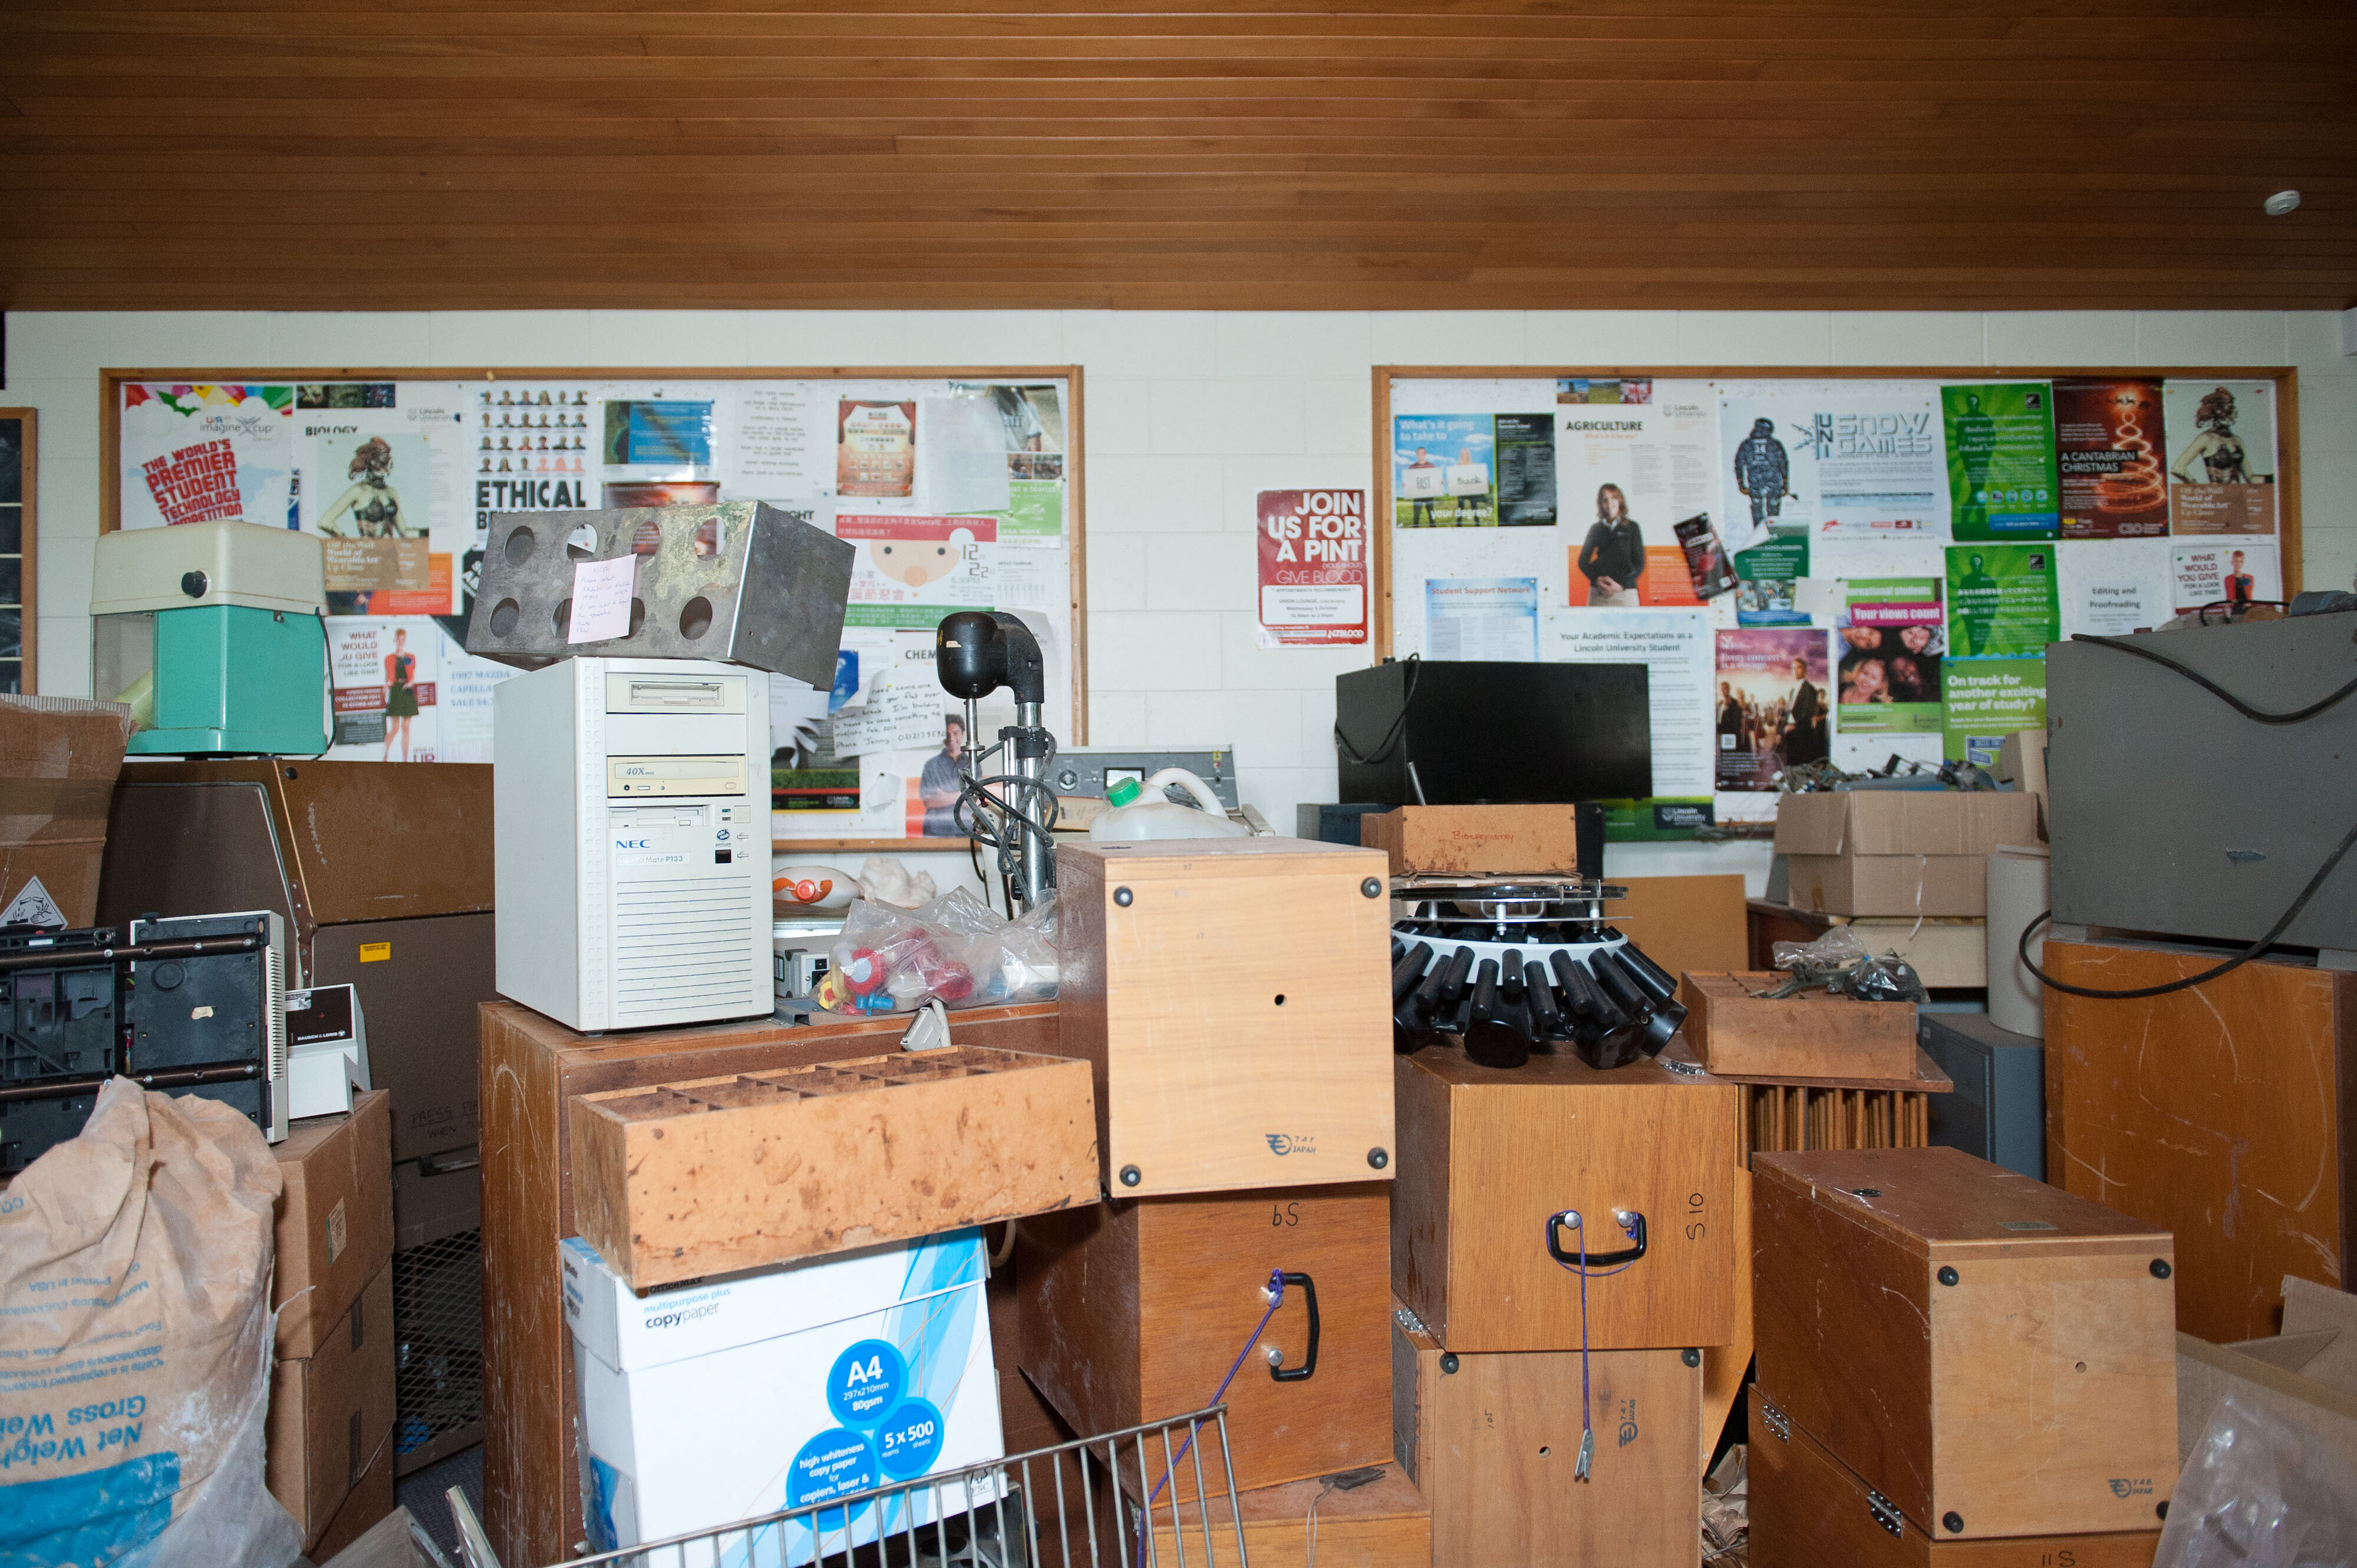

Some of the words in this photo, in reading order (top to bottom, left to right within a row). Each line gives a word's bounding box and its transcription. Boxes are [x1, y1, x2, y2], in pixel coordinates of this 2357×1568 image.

[199, 423, 241, 434] imagine
[252, 424, 272, 434] cup
[1400, 420, 1436, 430] What's
[1448, 420, 1474, 431] going
[1565, 421, 1643, 431] AGRICULTURE
[1837, 412, 1930, 435] SNOW
[305, 425, 358, 436] BIOLOGY
[1400, 431, 1412, 441] to
[1413, 431, 1434, 440] take
[1436, 431, 1447, 440] to
[141, 455, 167, 474] THE
[171, 438, 232, 461] WORLD'S
[2061, 452, 2070, 461] A
[2071, 451, 2135, 461] CANTABRIAN
[145, 451, 237, 492] PREMIER
[2061, 462, 2119, 472] CHRISTMAS
[153, 470, 237, 509] STUDENT
[476, 480, 586, 507] ETHICAL
[161, 489, 240, 521] TECHNOLOGY
[1294, 492, 1361, 516] JOIN
[1430, 509, 1453, 520] your
[1454, 507, 1494, 519] degree?
[1267, 516, 1302, 539] US
[1308, 516, 1362, 539] FOR
[1275, 539, 1298, 562] A
[1304, 539, 1362, 562] PINT
[2184, 563, 2218, 572] WOULD
[1275, 570, 1309, 583] GIVE
[1313, 569, 1363, 583] BLOOD
[2177, 574, 2197, 582] YOU
[2198, 572, 2220, 580] GIVE
[1431, 586, 1462, 595] Student
[1465, 586, 1495, 595] Support
[2092, 586, 2119, 595] Editing
[2089, 600, 2141, 609] Proofreading
[1854, 608, 1877, 619] Your
[1878, 608, 1908, 619] views
[1910, 608, 1940, 619] count
[349, 631, 377, 640] WHAT
[1624, 632, 1674, 641] Expectations
[341, 642, 378, 651] WOULD
[1574, 643, 1604, 652] Lincoln
[1607, 643, 1647, 653] University
[1649, 643, 1681, 651] Student
[355, 651, 378, 660] GIVE
[905, 649, 937, 659] CHEM
[1721, 653, 1744, 662] Every
[475, 669, 510, 679] MAZDA
[1947, 675, 1966, 686] On
[1967, 674, 2001, 686] track
[2002, 674, 2022, 685] for
[450, 685, 492, 694] CAPELLA
[1949, 688, 1997, 698] another
[1998, 686, 2046, 699] exciting
[1949, 701, 1977, 713] year
[1979, 698, 1993, 709] of
[1993, 698, 2036, 711] study?
[1673, 813, 1706, 821] University
[616, 840, 651, 849] NEC
[28, 1280, 56, 1292] USA
[644, 1292, 708, 1314] multipurpose
[711, 1287, 731, 1300] plus
[846, 1355, 883, 1388] A4
[843, 1381, 889, 1401] 297x210mm
[852, 1395, 884, 1412] 80gsm
[67, 1395, 146, 1427] Gross
[0, 1412, 55, 1442] Wei
[96, 1422, 143, 1453] Net
[884, 1432, 895, 1449] 5
[895, 1431, 906, 1445] x
[907, 1420, 934, 1442] 500
[0, 1436, 86, 1470] Weigh
[881, 1447, 899, 1458] reams
[912, 1438, 931, 1449] sheets
[799, 1455, 820, 1470] high
[821, 1442, 865, 1463] whiteness
[809, 1465, 830, 1478] copy
[832, 1457, 857, 1473] paper
[829, 1473, 839, 1483] for
[799, 1486, 836, 1503] copiers,
[838, 1478, 860, 1491] laser
[861, 1473, 869, 1483] &
